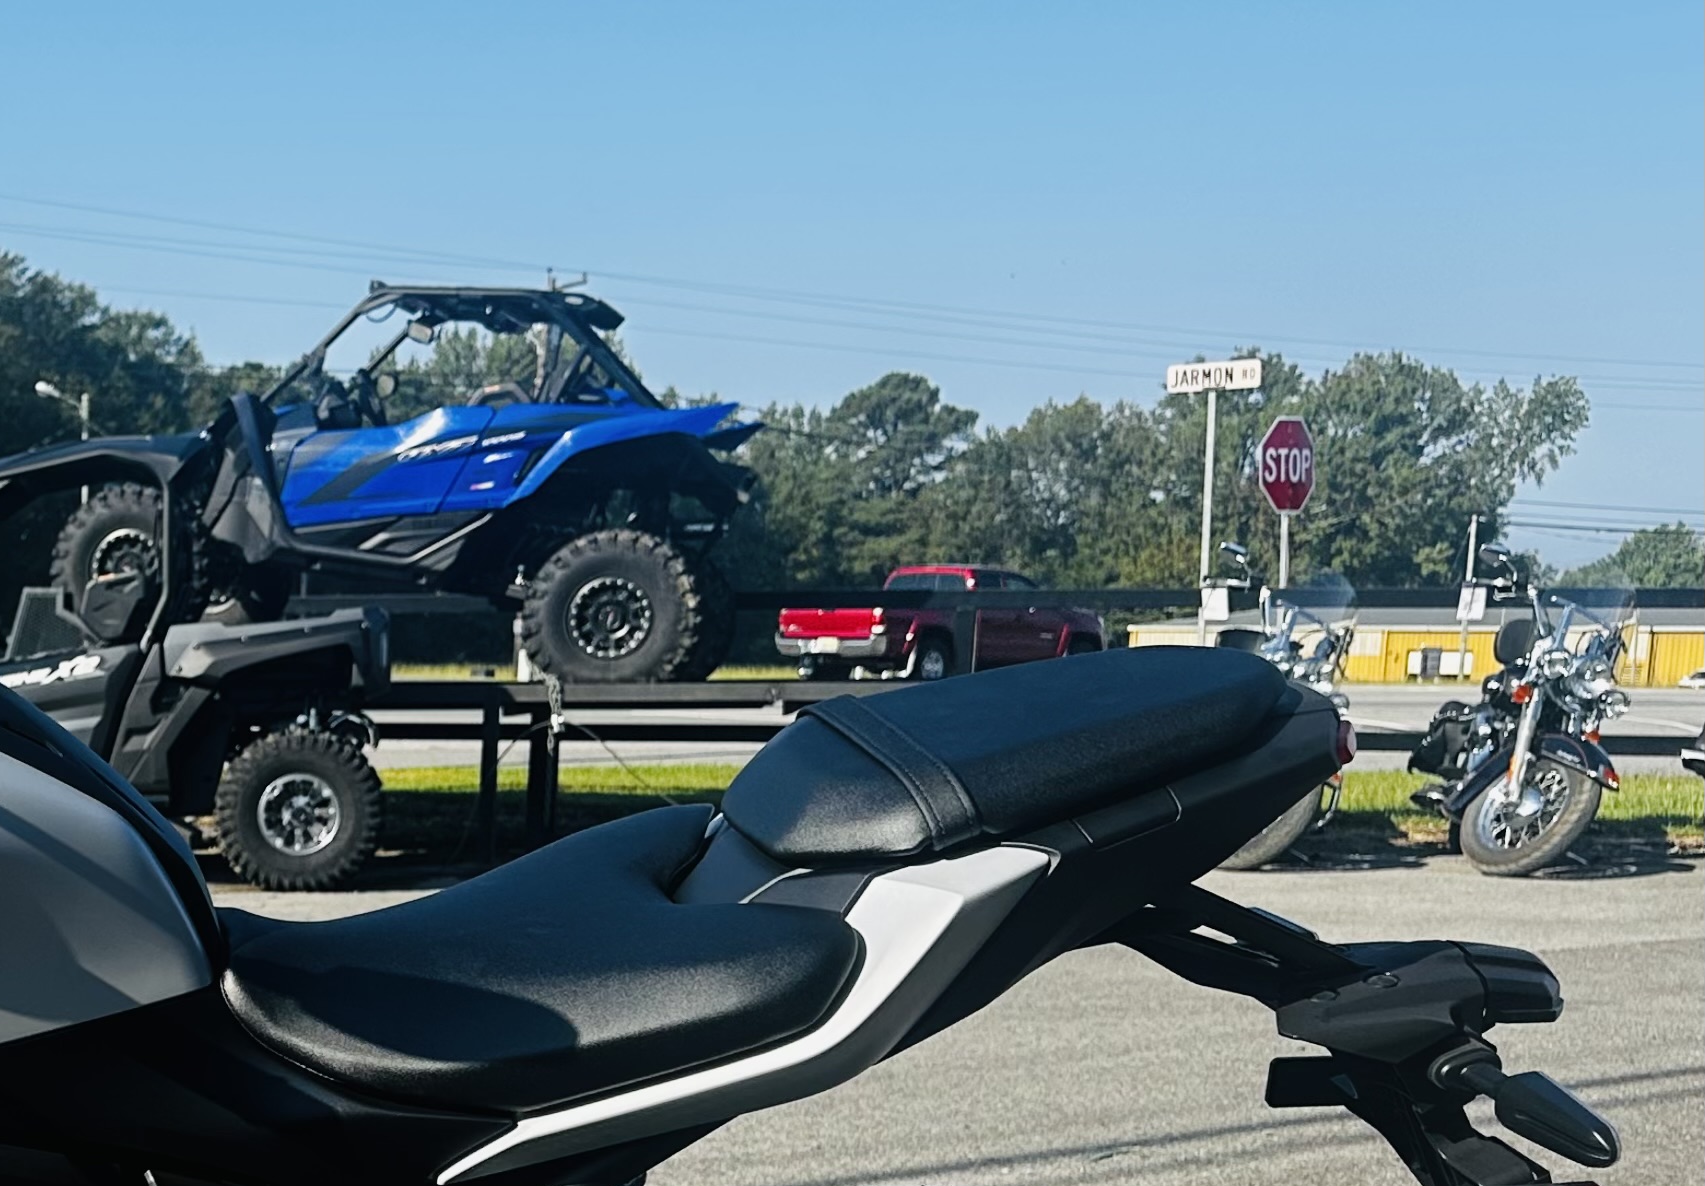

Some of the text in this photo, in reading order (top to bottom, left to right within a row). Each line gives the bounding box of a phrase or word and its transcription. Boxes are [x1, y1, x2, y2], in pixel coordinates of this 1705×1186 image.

[1171, 366, 1256, 388] JARMON RD
[1264, 447, 1311, 483] STOP
